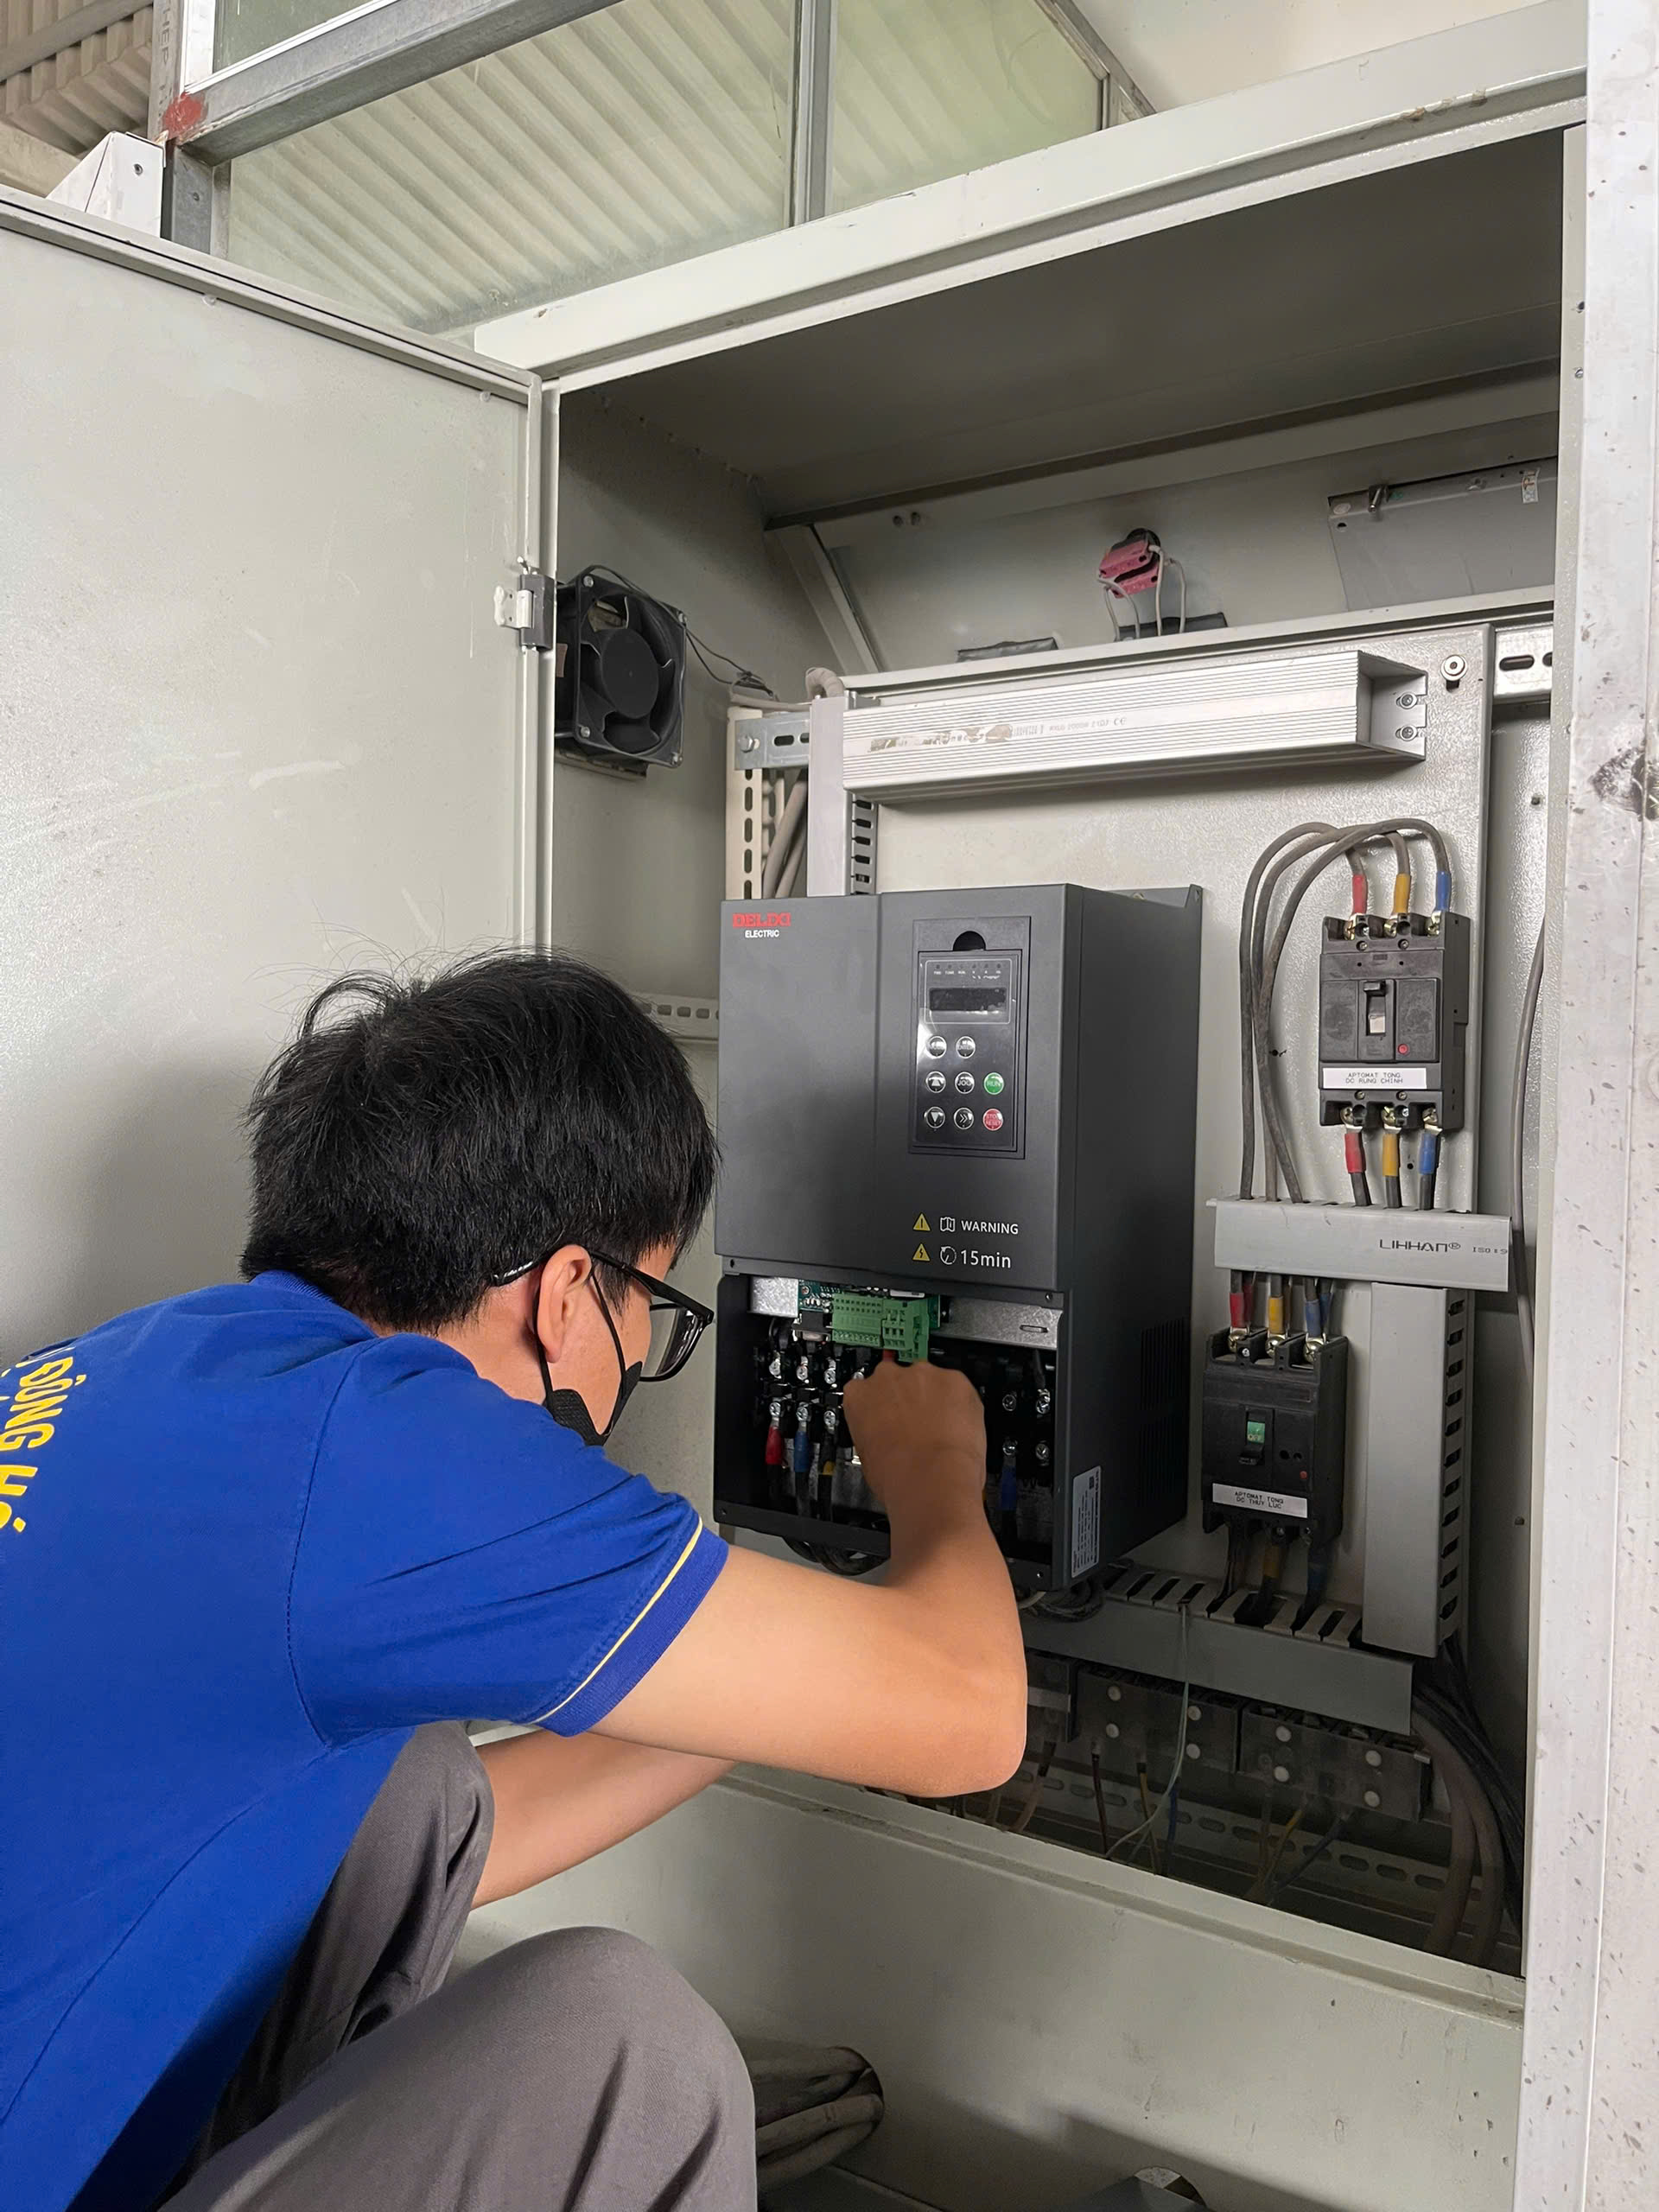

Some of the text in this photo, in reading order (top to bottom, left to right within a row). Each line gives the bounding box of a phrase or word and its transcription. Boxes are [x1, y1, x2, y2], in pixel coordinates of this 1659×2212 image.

[745, 929, 780, 938] ELECTRIC
[961, 1220, 1019, 1235] WARNING
[960, 1249, 1011, 1268] 15min
[1234, 1491, 1262, 1500] APTOMAT
